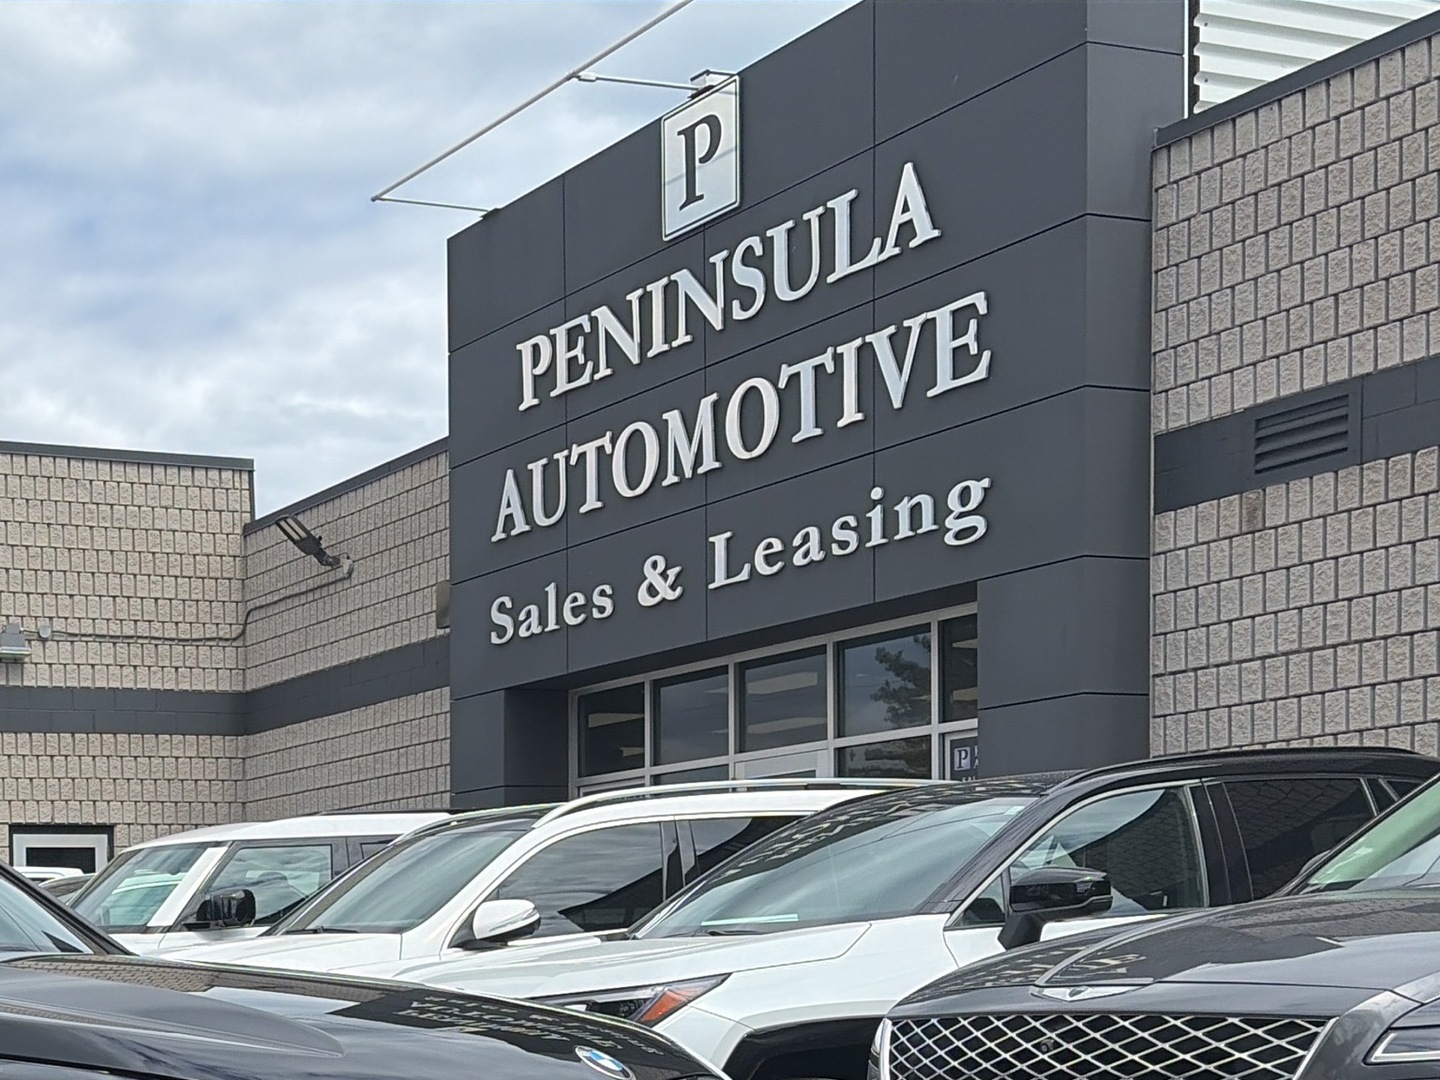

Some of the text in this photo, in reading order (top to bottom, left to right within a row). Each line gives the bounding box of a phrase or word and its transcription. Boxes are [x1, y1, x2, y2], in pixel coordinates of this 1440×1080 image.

[675, 113, 723, 212] P
[515, 161, 942, 412] PENINSULA
[490, 291, 992, 543] AUTOMOTIVE
[490, 477, 992, 645] Sales & Leasing
[956, 748, 969, 769] P
